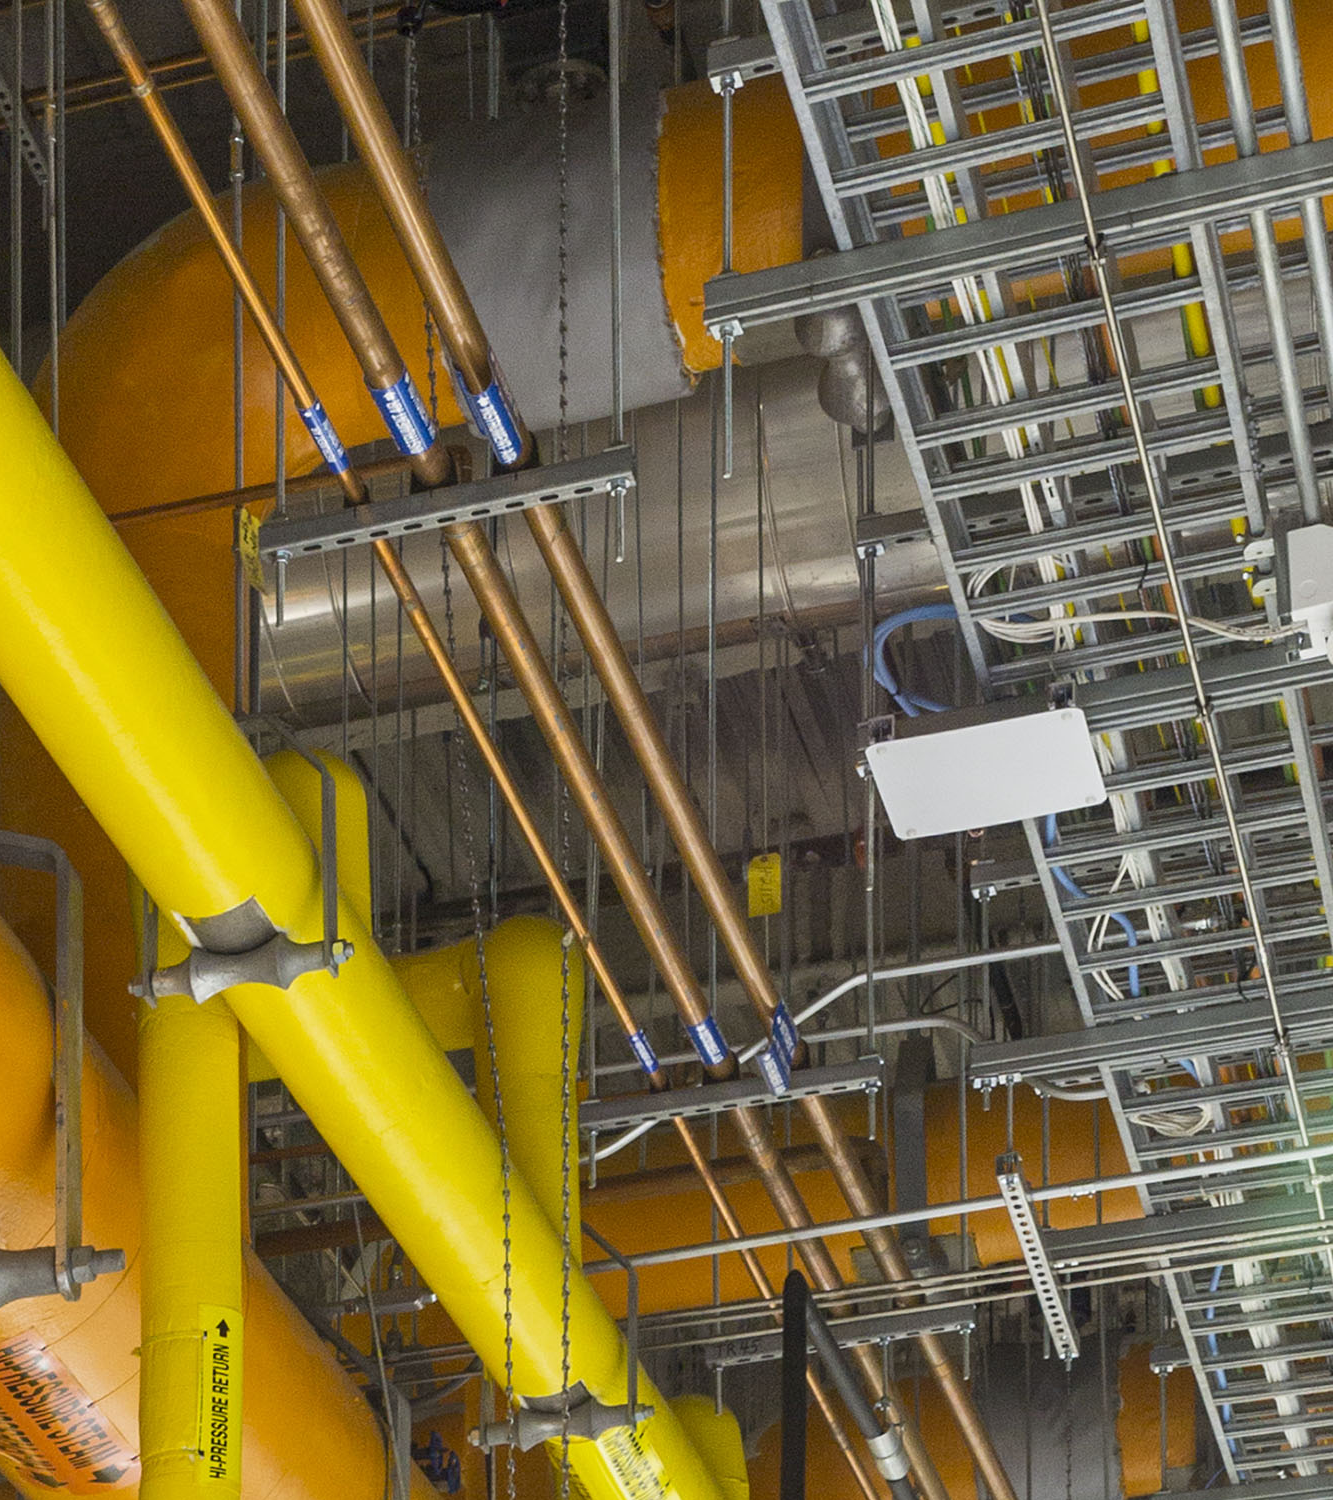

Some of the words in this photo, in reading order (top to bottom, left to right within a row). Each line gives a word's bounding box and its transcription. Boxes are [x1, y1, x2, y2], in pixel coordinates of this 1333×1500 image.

[216, 1343, 232, 1394] RETURN
[57, 1418, 122, 1471] STEAM
[209, 1394, 231, 1480] HI-PRESSURE
